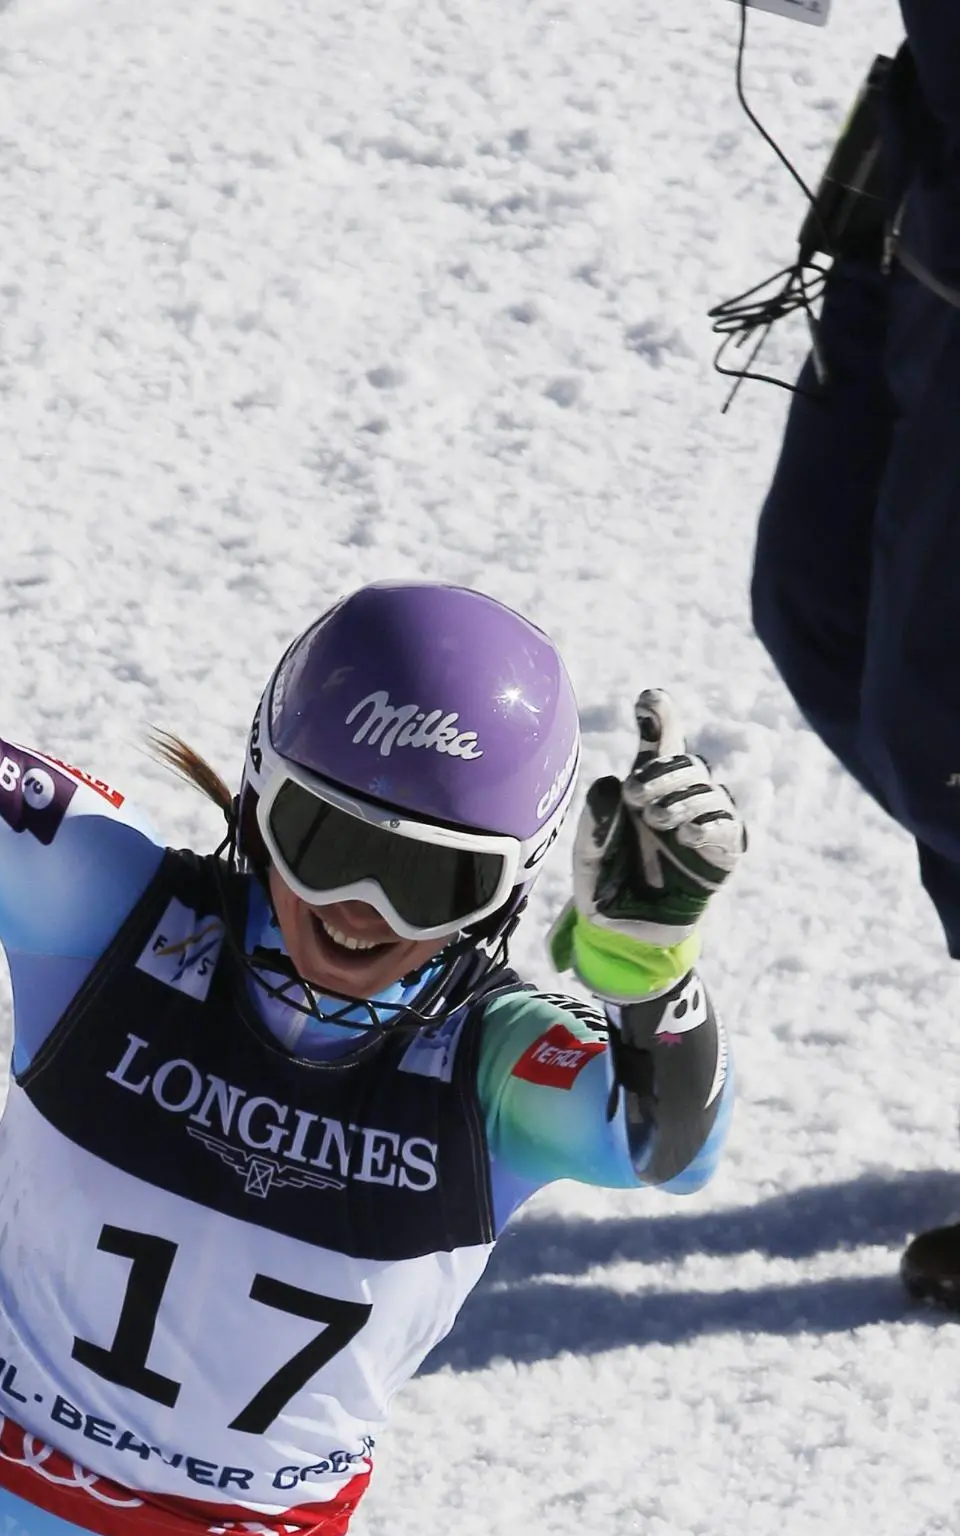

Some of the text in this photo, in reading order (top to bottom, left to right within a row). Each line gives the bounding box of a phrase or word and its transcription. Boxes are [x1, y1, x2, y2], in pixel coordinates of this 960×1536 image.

[345, 690, 484, 760] Milka
[106, 1032, 438, 1192] LONGINES
[71, 1223, 373, 1435] 17
